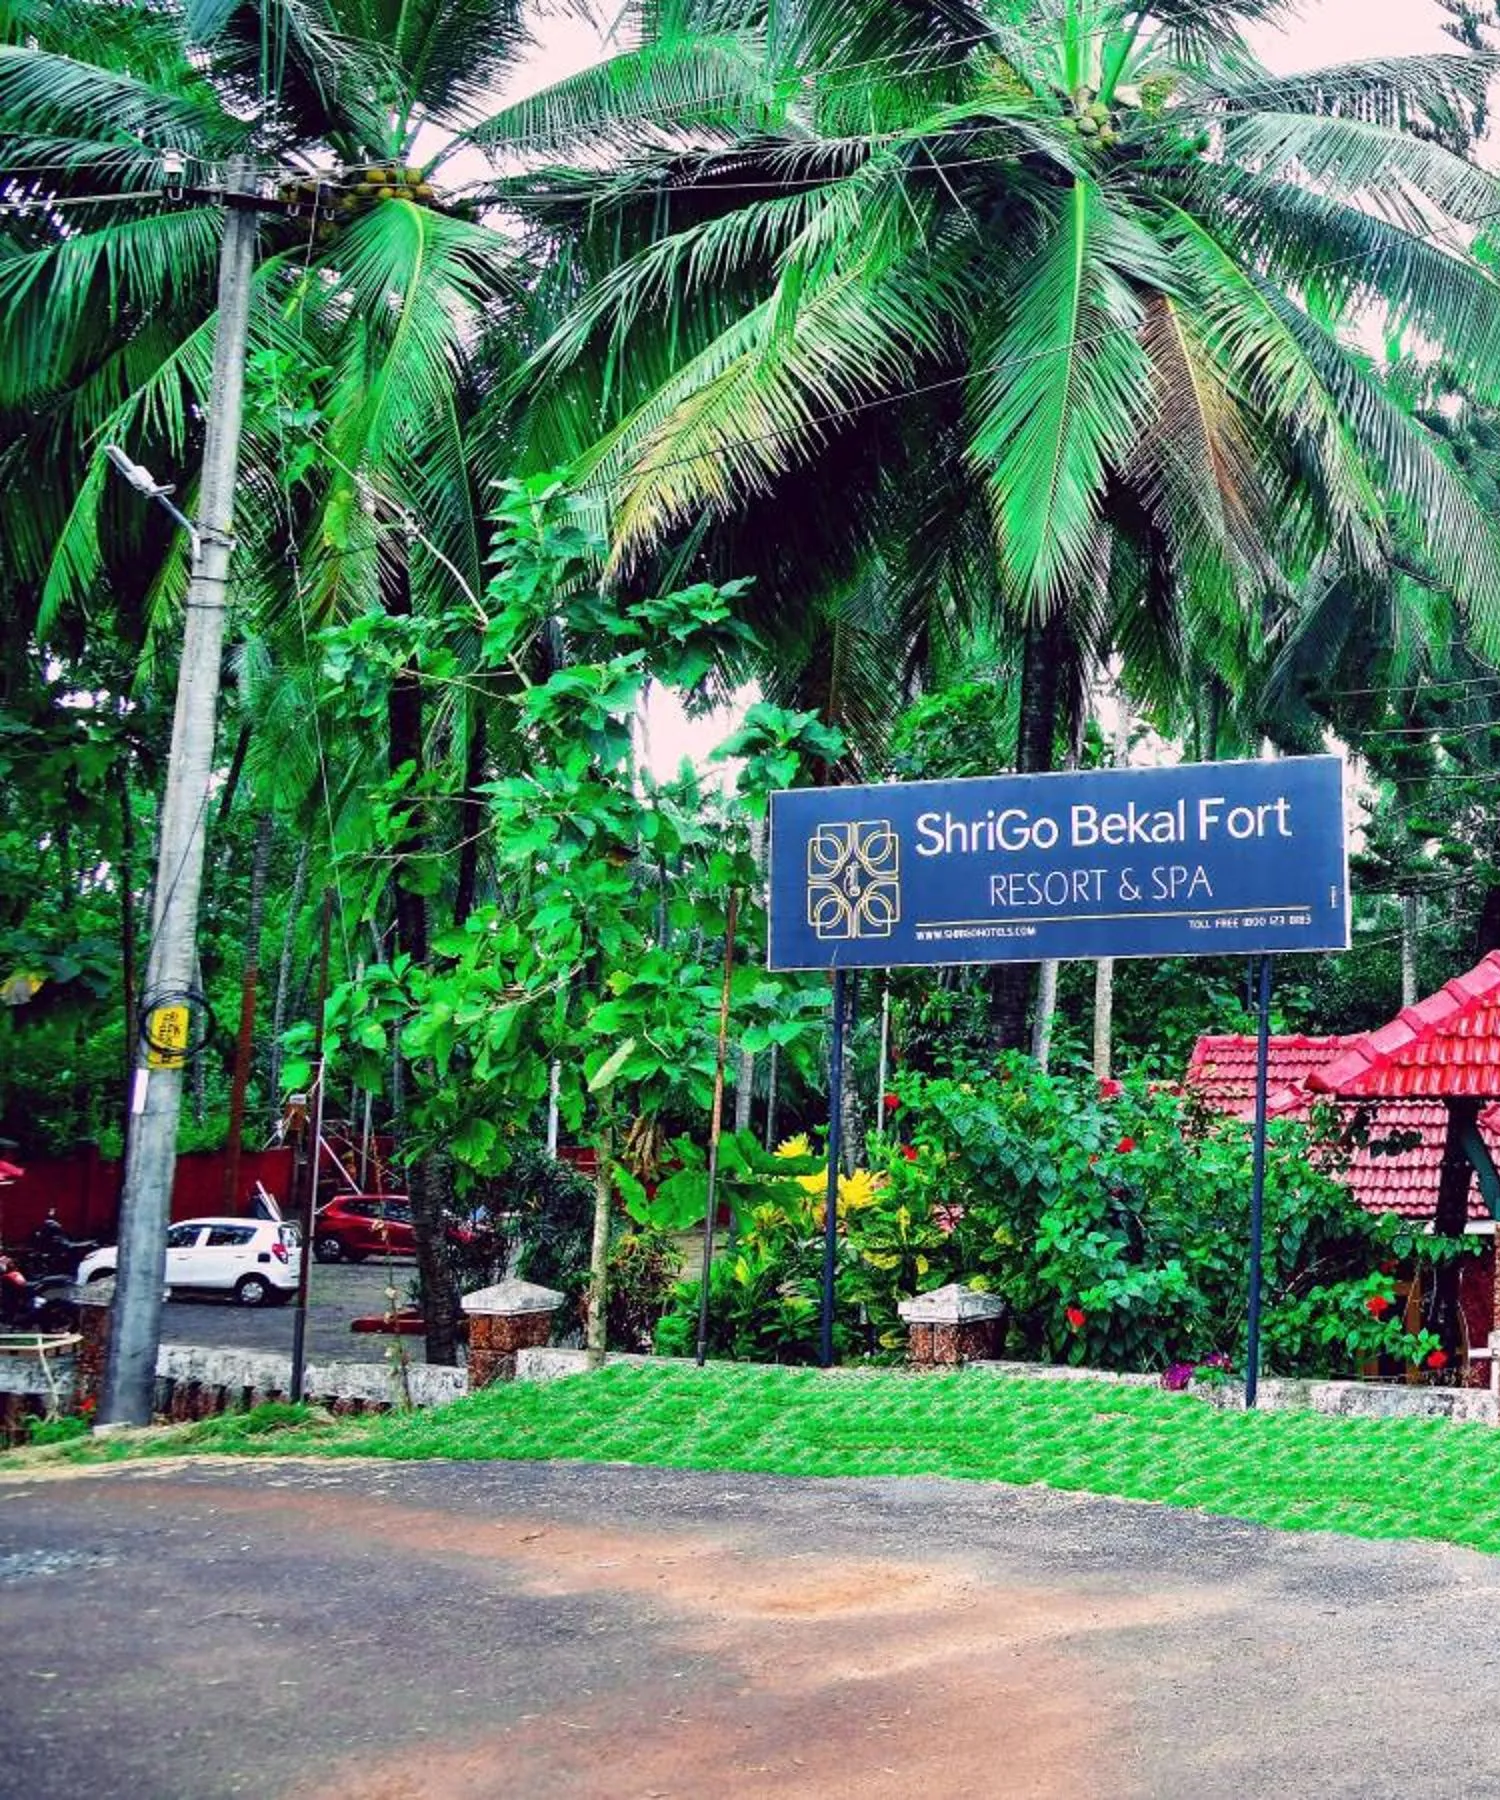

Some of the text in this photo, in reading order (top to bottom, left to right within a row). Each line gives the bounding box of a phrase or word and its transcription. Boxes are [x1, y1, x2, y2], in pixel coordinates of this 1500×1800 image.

[915, 797, 1293, 857] ShriGo Bekal Fort
[989, 865, 1213, 907] RESORT & SPA
[1188, 919, 1212, 929] TOLL
[1214, 917, 1239, 929] FREE
